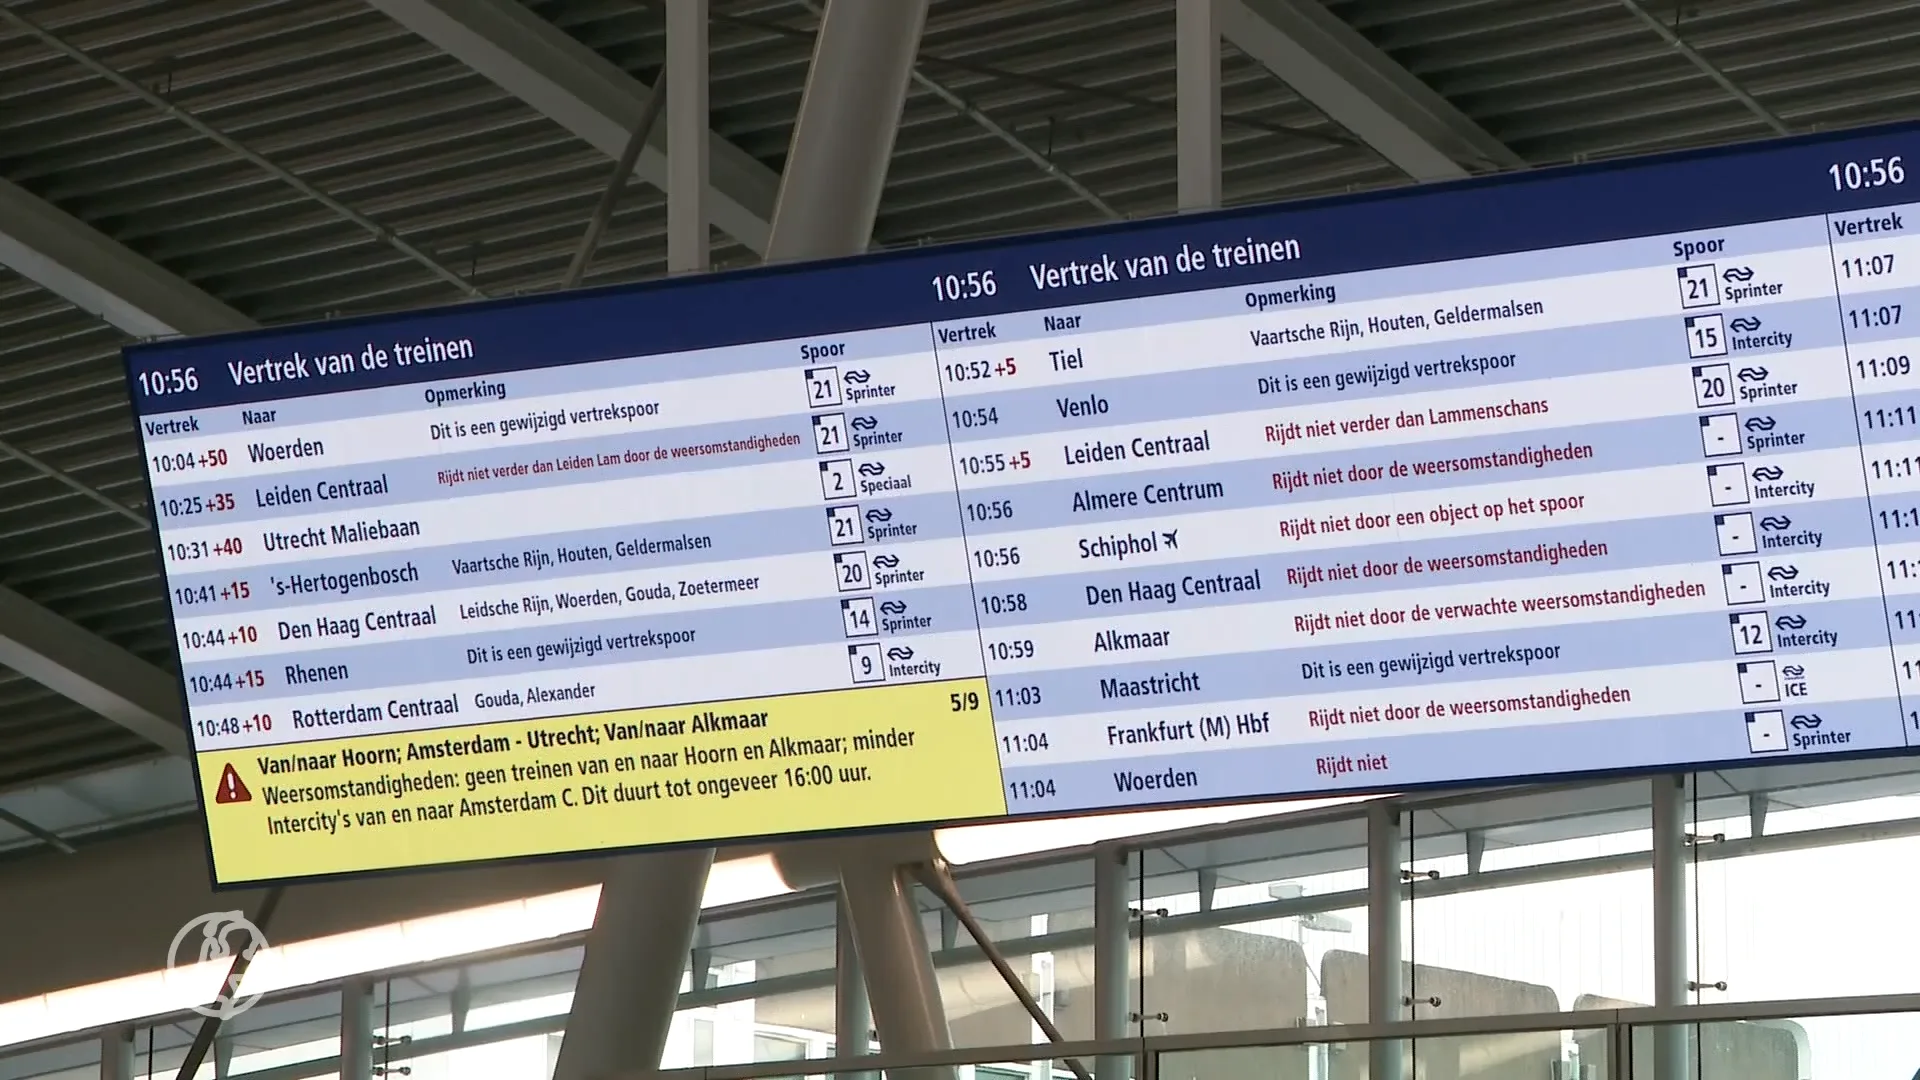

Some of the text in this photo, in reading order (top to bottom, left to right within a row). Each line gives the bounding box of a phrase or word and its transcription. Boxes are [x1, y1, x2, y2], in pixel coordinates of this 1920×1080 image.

[1829, 156, 1904, 190] 10:56
[1842, 254, 1893, 278] 11:07
[932, 270, 996, 300] 10:56
[938, 321, 996, 343] Vertrek
[1695, 327, 1717, 348] 15
[1731, 330, 1793, 351] Intercity
[227, 337, 473, 385] Vertrek van de treinen
[800, 343, 845, 363] Spoor
[1048, 347, 1083, 371] Tiel
[1856, 355, 1910, 378] 11:09
[139, 367, 198, 395] 10:56
[813, 379, 831, 399] 21
[424, 380, 506, 407] Opmerking
[844, 383, 896, 404] Sprinter
[1056, 393, 1108, 418] Venlo
[145, 415, 199, 435] Vertrek
[241, 409, 277, 425] Naar
[429, 402, 659, 441] Dit is een gewijzigd vertrekspoor
[952, 407, 998, 428] 10:54
[1265, 398, 1548, 445] Rijdt niet verder dan Lammenschans
[1864, 406, 1915, 428] 11:11
[247, 437, 323, 462] Woerden
[436, 432, 800, 488] Rijdt niet verder dan Leiden Lam door de weersomstandigheden
[255, 473, 388, 507] Leiden Centraal
[831, 471, 844, 491] 2
[860, 474, 911, 496] Speciaal
[1073, 482, 1223, 512] Almere Centrum
[967, 500, 1013, 521] 10:56
[1279, 495, 1584, 540] Rijdt niet door een object op het spoor
[263, 519, 420, 551] Utrecht Maliebaan
[1079, 530, 1157, 560] Schiphol
[451, 533, 711, 574] Vaartsche Rijn, Houten, Geldermalsen
[1287, 540, 1608, 588] Rijdt niet door de weersomstandigheden
[270, 561, 418, 595] 's-Hertogenbosch
[842, 563, 862, 583] 20
[873, 568, 925, 588] Sprinter
[459, 576, 760, 619] Leidsche Rijn, Woerden, Gouda, Zoetermeer
[981, 593, 1027, 614] 10:58
[1294, 580, 1705, 635] Rijdt niet door de verwachte weersomstandigheden
[276, 604, 436, 641] Den Haag Centraal
[1740, 624, 1762, 644] 12
[988, 639, 1034, 660] 10:59
[1094, 630, 1169, 652] Alkmaar
[285, 664, 348, 684] Rhenen
[860, 654, 872, 675] 9
[888, 659, 941, 677] Intercity
[473, 682, 595, 709] Gouda, Alexander
[995, 686, 1041, 706] 11:03
[1100, 671, 1200, 698] Maastricht
[1784, 681, 1808, 698] ICE
[292, 693, 459, 728] Rotterdam Centraal
[949, 691, 980, 712] 5/9
[1107, 711, 1269, 745] Frankfurt (M) Hbf
[257, 754, 336, 774] Van/naar
[340, 747, 402, 767] Hoorn;
[407, 734, 510, 760] Amsterdam
[527, 724, 600, 748] Utrecht;
[603, 719, 685, 741] Van/naar
[692, 711, 768, 733] Alkmaar
[1002, 732, 1048, 752] 11:04
[262, 727, 914, 805] Weersomstandigheden: geen treinen van en naar Hoorn en Alkmaar; minder
[267, 764, 872, 835] Intercity's van en naar Amsterdam C. Dit duurt tot ongeveer 16:00 uur.
